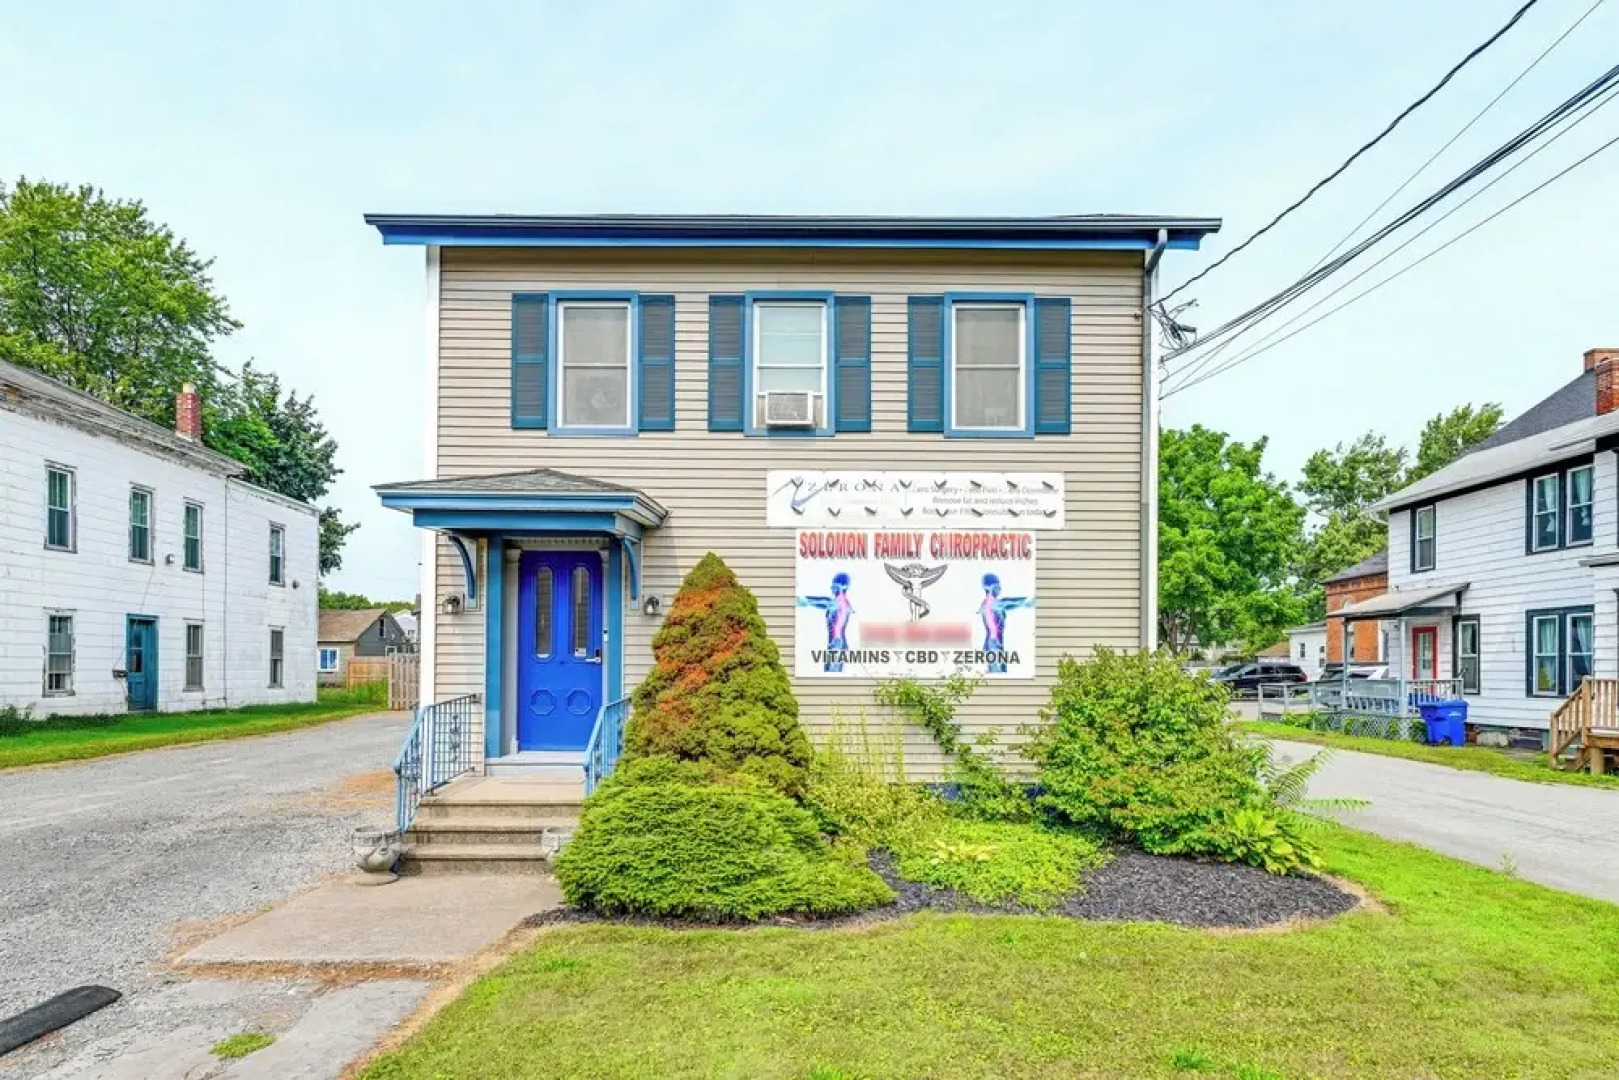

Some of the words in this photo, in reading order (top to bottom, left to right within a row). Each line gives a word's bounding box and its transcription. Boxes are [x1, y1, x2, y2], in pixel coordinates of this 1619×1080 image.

[799, 531, 868, 560] SOLOMON
[873, 532, 925, 560] FAMILY
[929, 532, 1033, 561] CHIROPRACTIC
[811, 650, 890, 664] VITAMINS
[904, 650, 939, 664] CBD
[952, 650, 1021, 664] ZERONA
